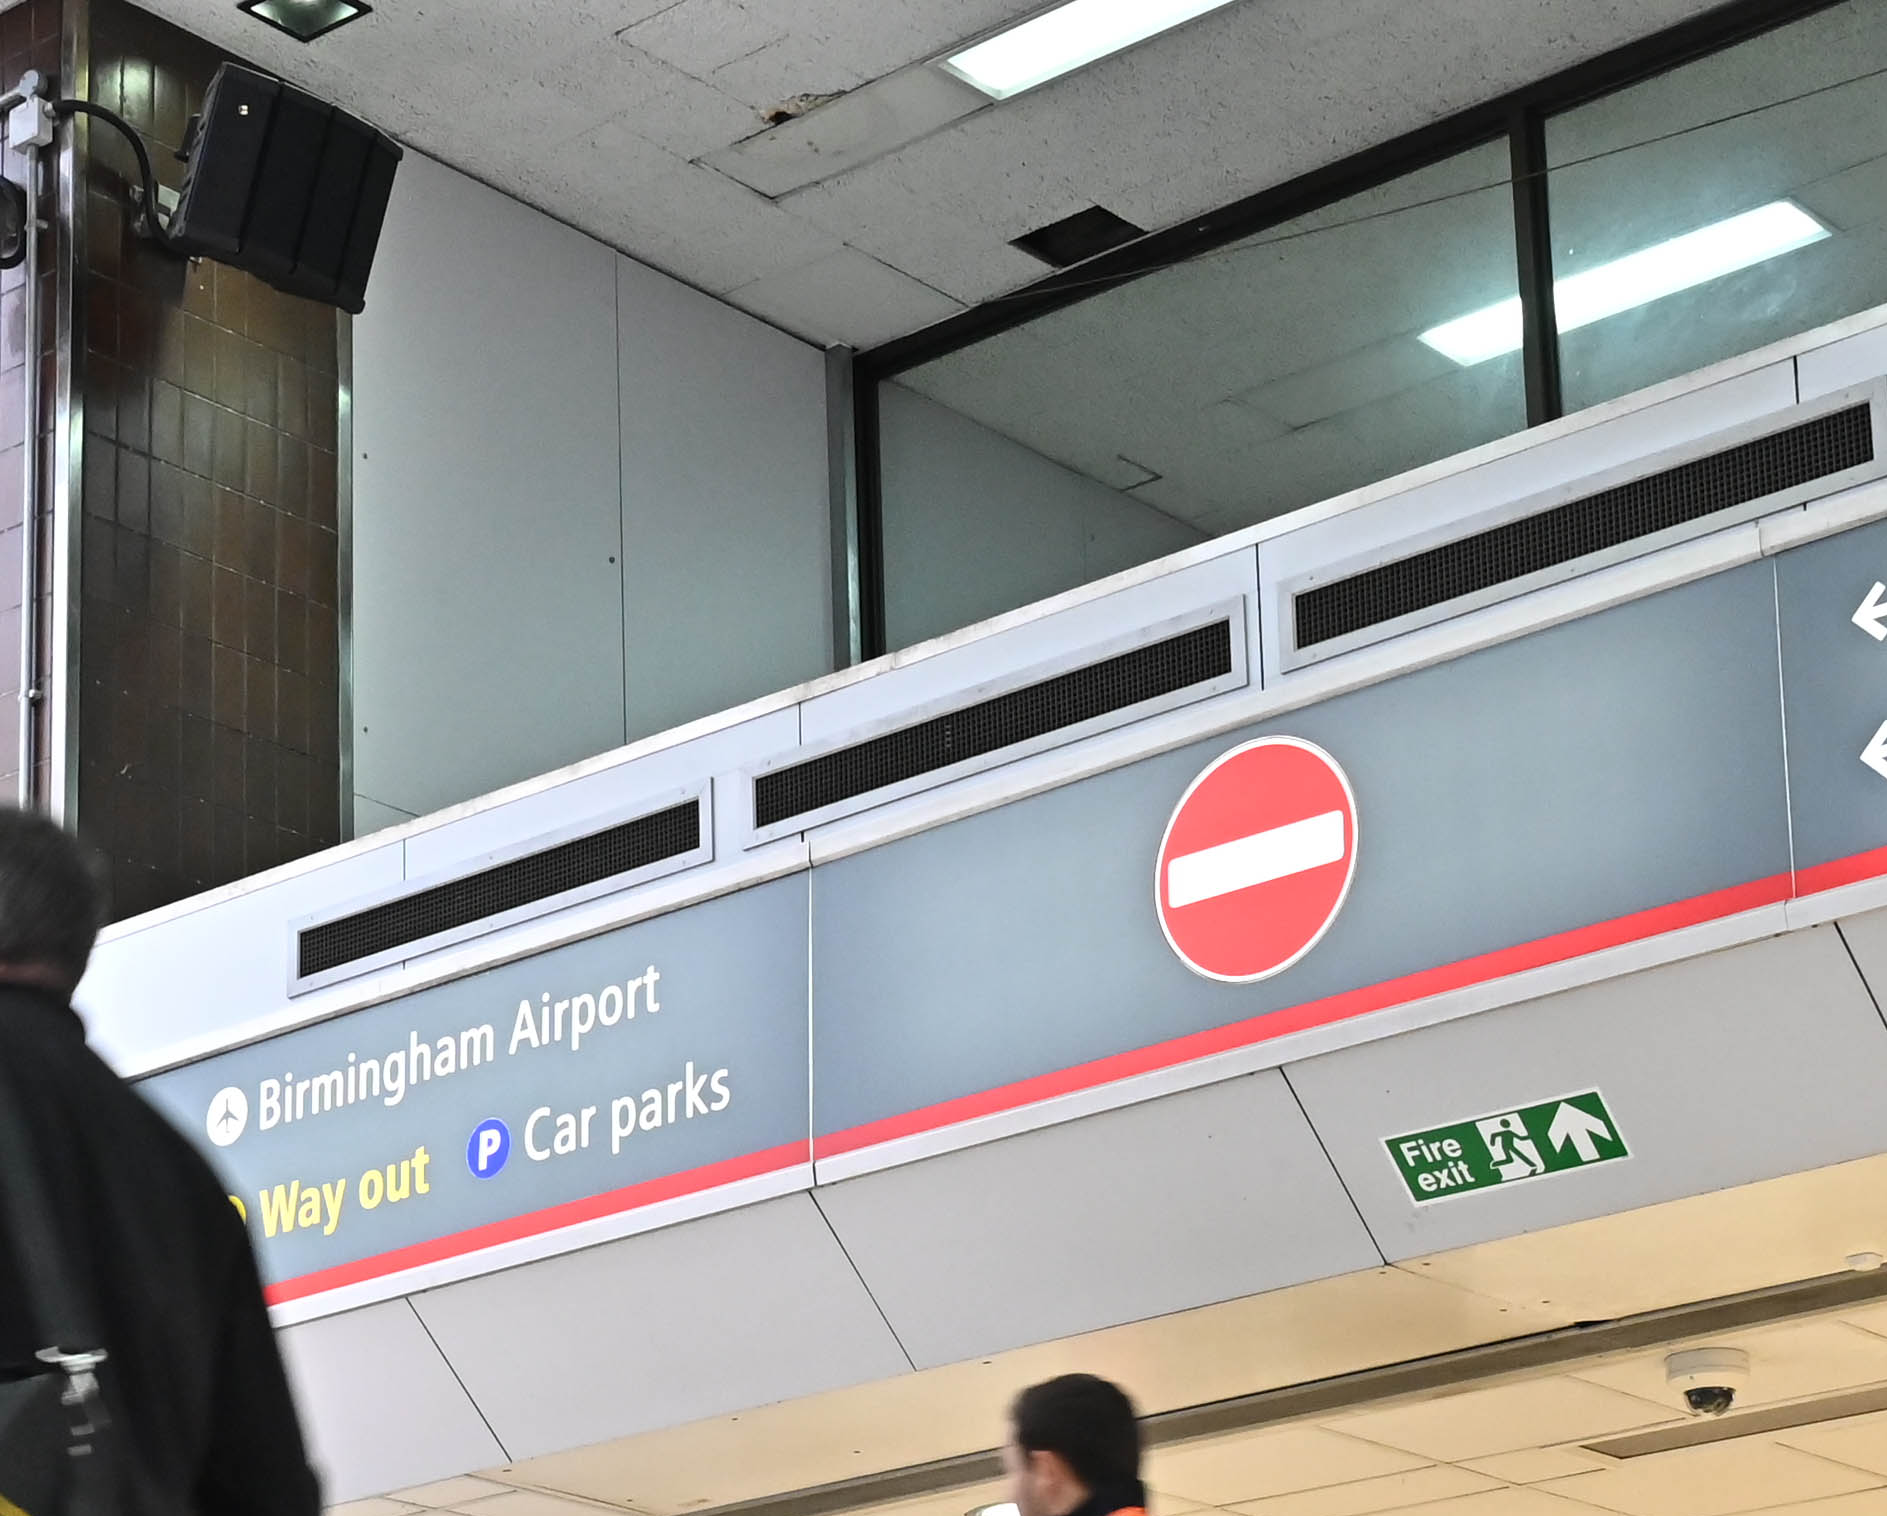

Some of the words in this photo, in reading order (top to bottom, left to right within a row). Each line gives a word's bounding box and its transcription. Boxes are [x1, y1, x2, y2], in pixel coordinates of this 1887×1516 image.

[259, 1023, 495, 1131] Birmingham
[508, 965, 661, 1056] Airport
[523, 1104, 598, 1162] Car
[611, 1060, 731, 1155] parks
[1399, 1138, 1463, 1168] Fire
[259, 1177, 347, 1239] Way
[358, 1145, 430, 1210] out
[1417, 1160, 1476, 1192] exit
